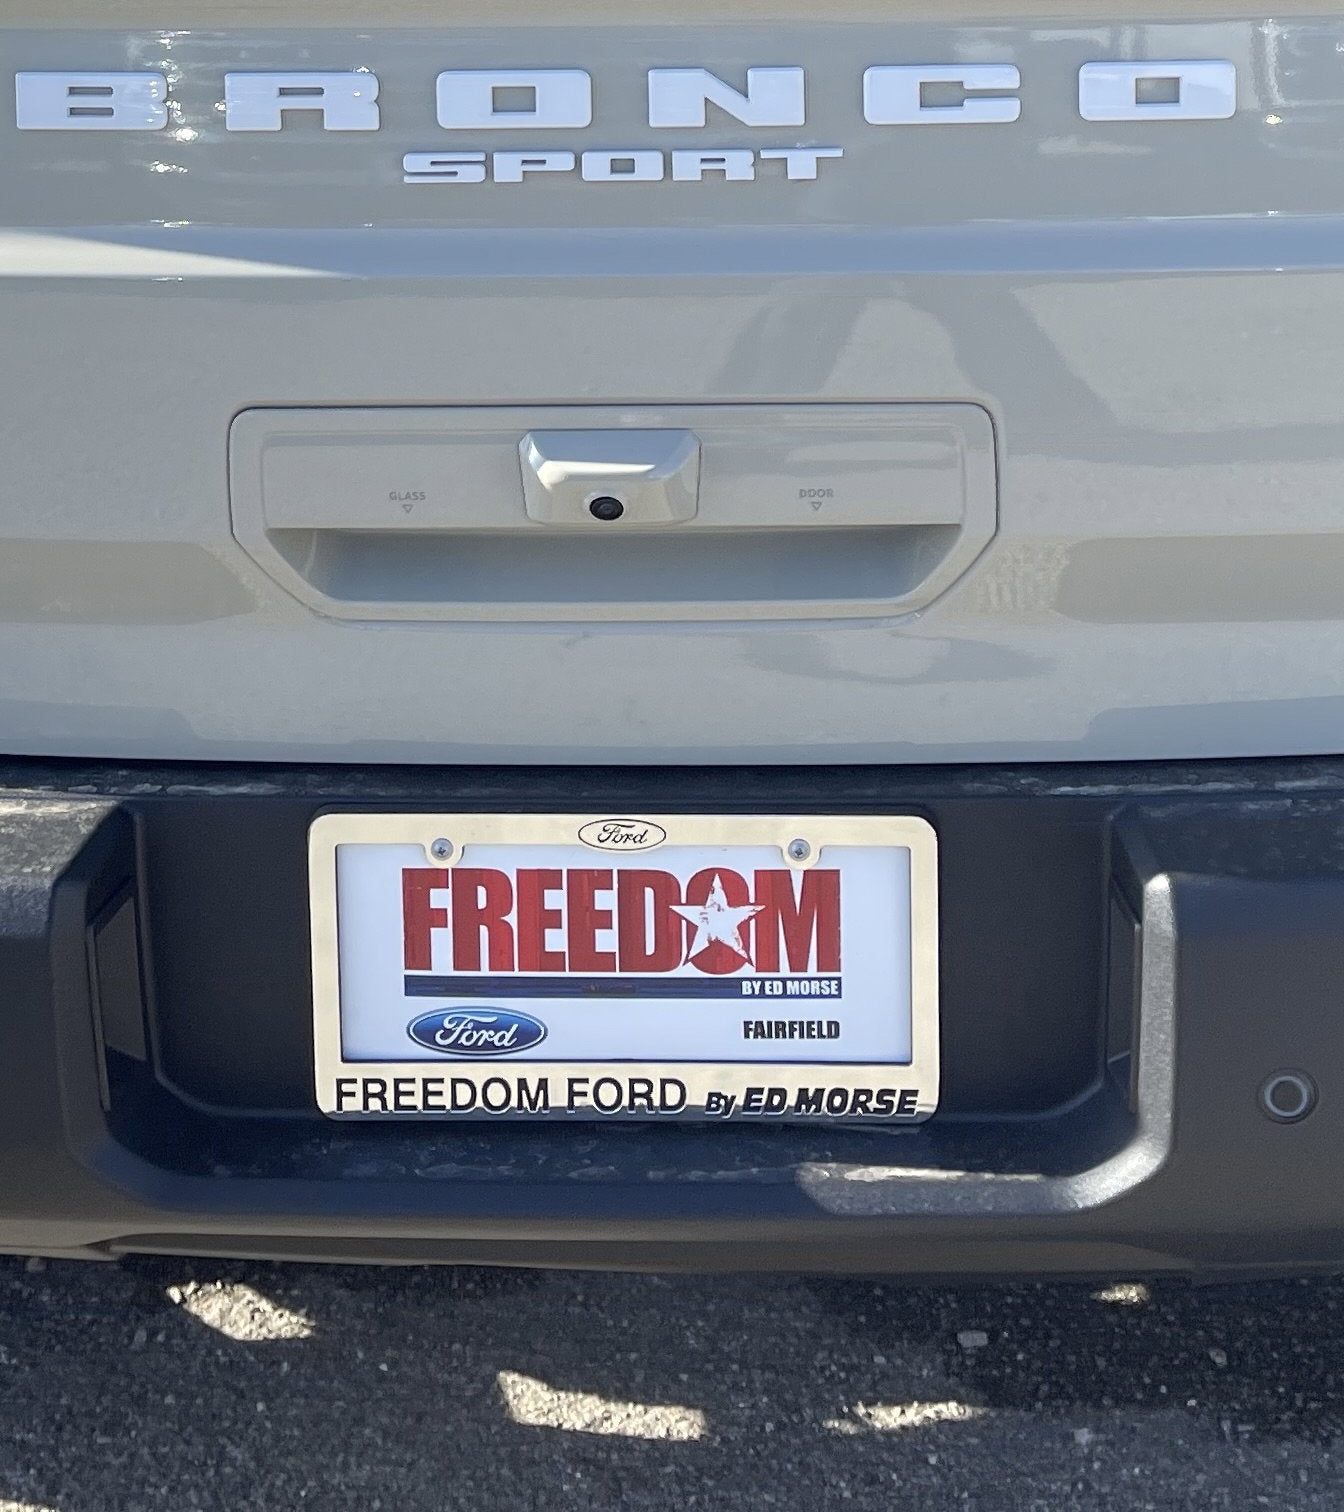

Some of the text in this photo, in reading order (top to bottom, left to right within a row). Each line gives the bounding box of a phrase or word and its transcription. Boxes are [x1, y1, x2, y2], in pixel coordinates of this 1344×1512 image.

[15, 59, 1237, 132] BRONCO
[402, 147, 844, 184] SPORT
[389, 491, 426, 500] GLASS
[799, 488, 834, 498] DOOR
[597, 823, 649, 844] Ford
[402, 868, 841, 975] FREEDOM
[741, 980, 838, 995] BY ED MORSE
[434, 1015, 518, 1048] Ford
[743, 1021, 841, 1039] FAIRFIELD
[335, 1077, 919, 1119] FREEDOM FORD By ED MORSE
